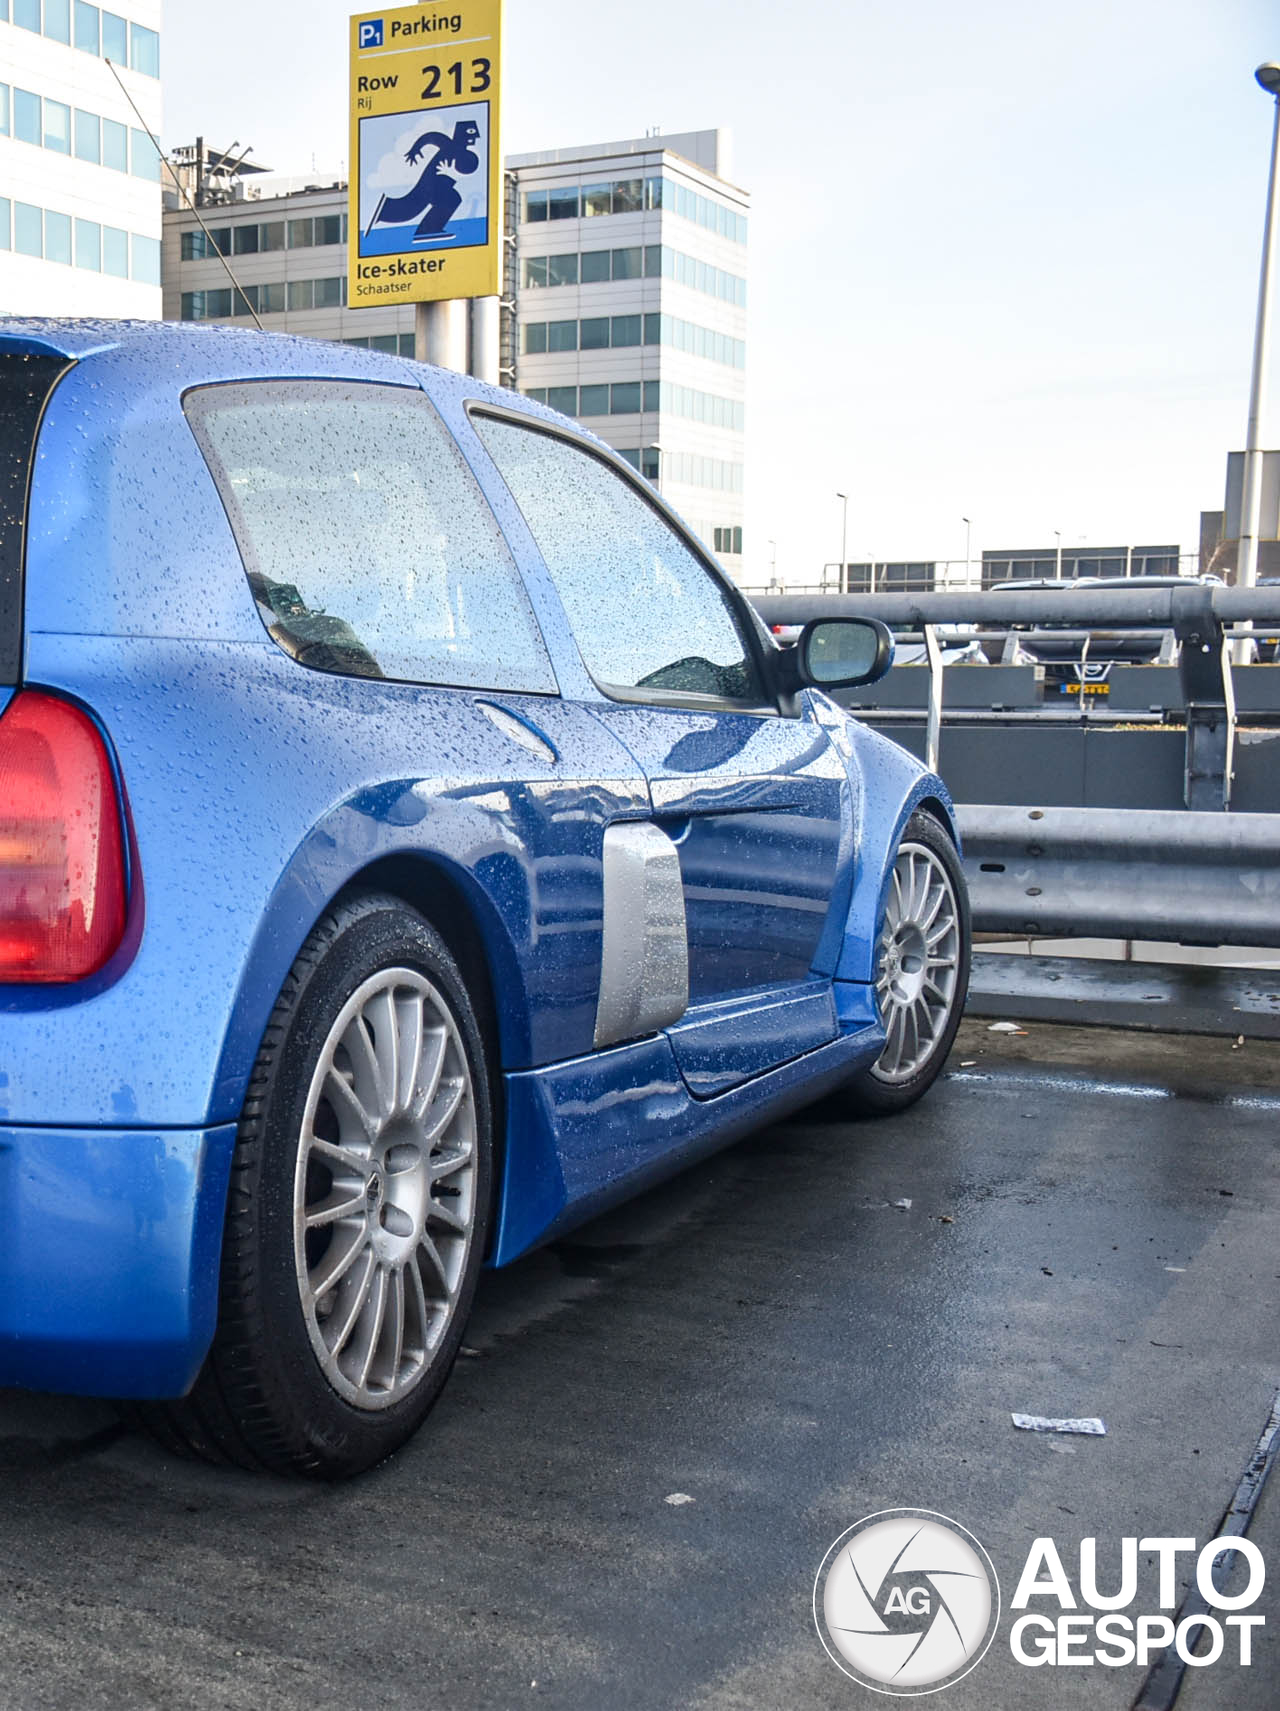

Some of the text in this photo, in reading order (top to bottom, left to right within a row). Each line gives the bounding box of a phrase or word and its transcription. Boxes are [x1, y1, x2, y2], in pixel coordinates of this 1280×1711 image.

[391, 14, 462, 37] Parking
[357, 58, 491, 99] Row 213
[357, 97, 372, 110] Rij
[357, 257, 445, 279] Ice-skater
[356, 282, 412, 296] Schaatser
